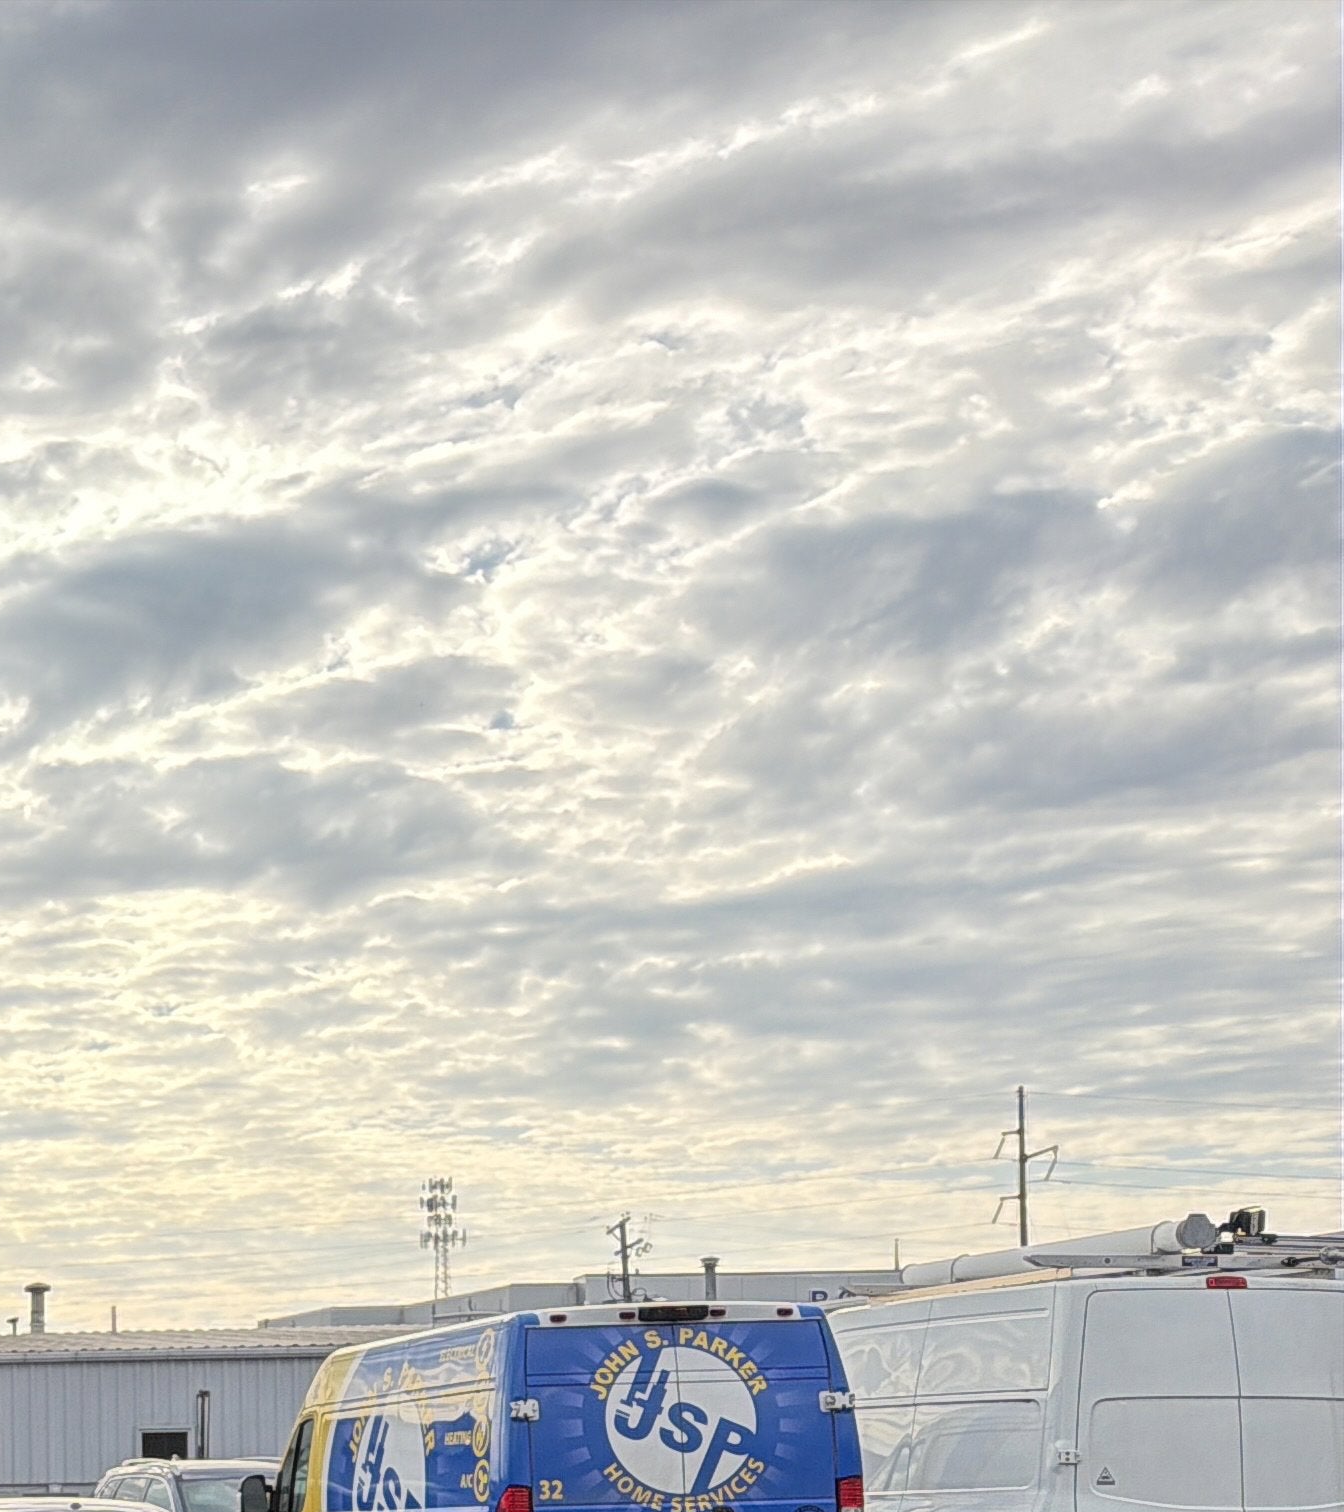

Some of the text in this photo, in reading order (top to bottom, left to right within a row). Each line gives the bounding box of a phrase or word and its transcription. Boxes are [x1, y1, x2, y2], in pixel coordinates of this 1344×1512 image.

[590, 1328, 768, 1400] JOHN S. PARKER
[539, 1480, 563, 1500] 32
[603, 1463, 665, 1512] HOME
